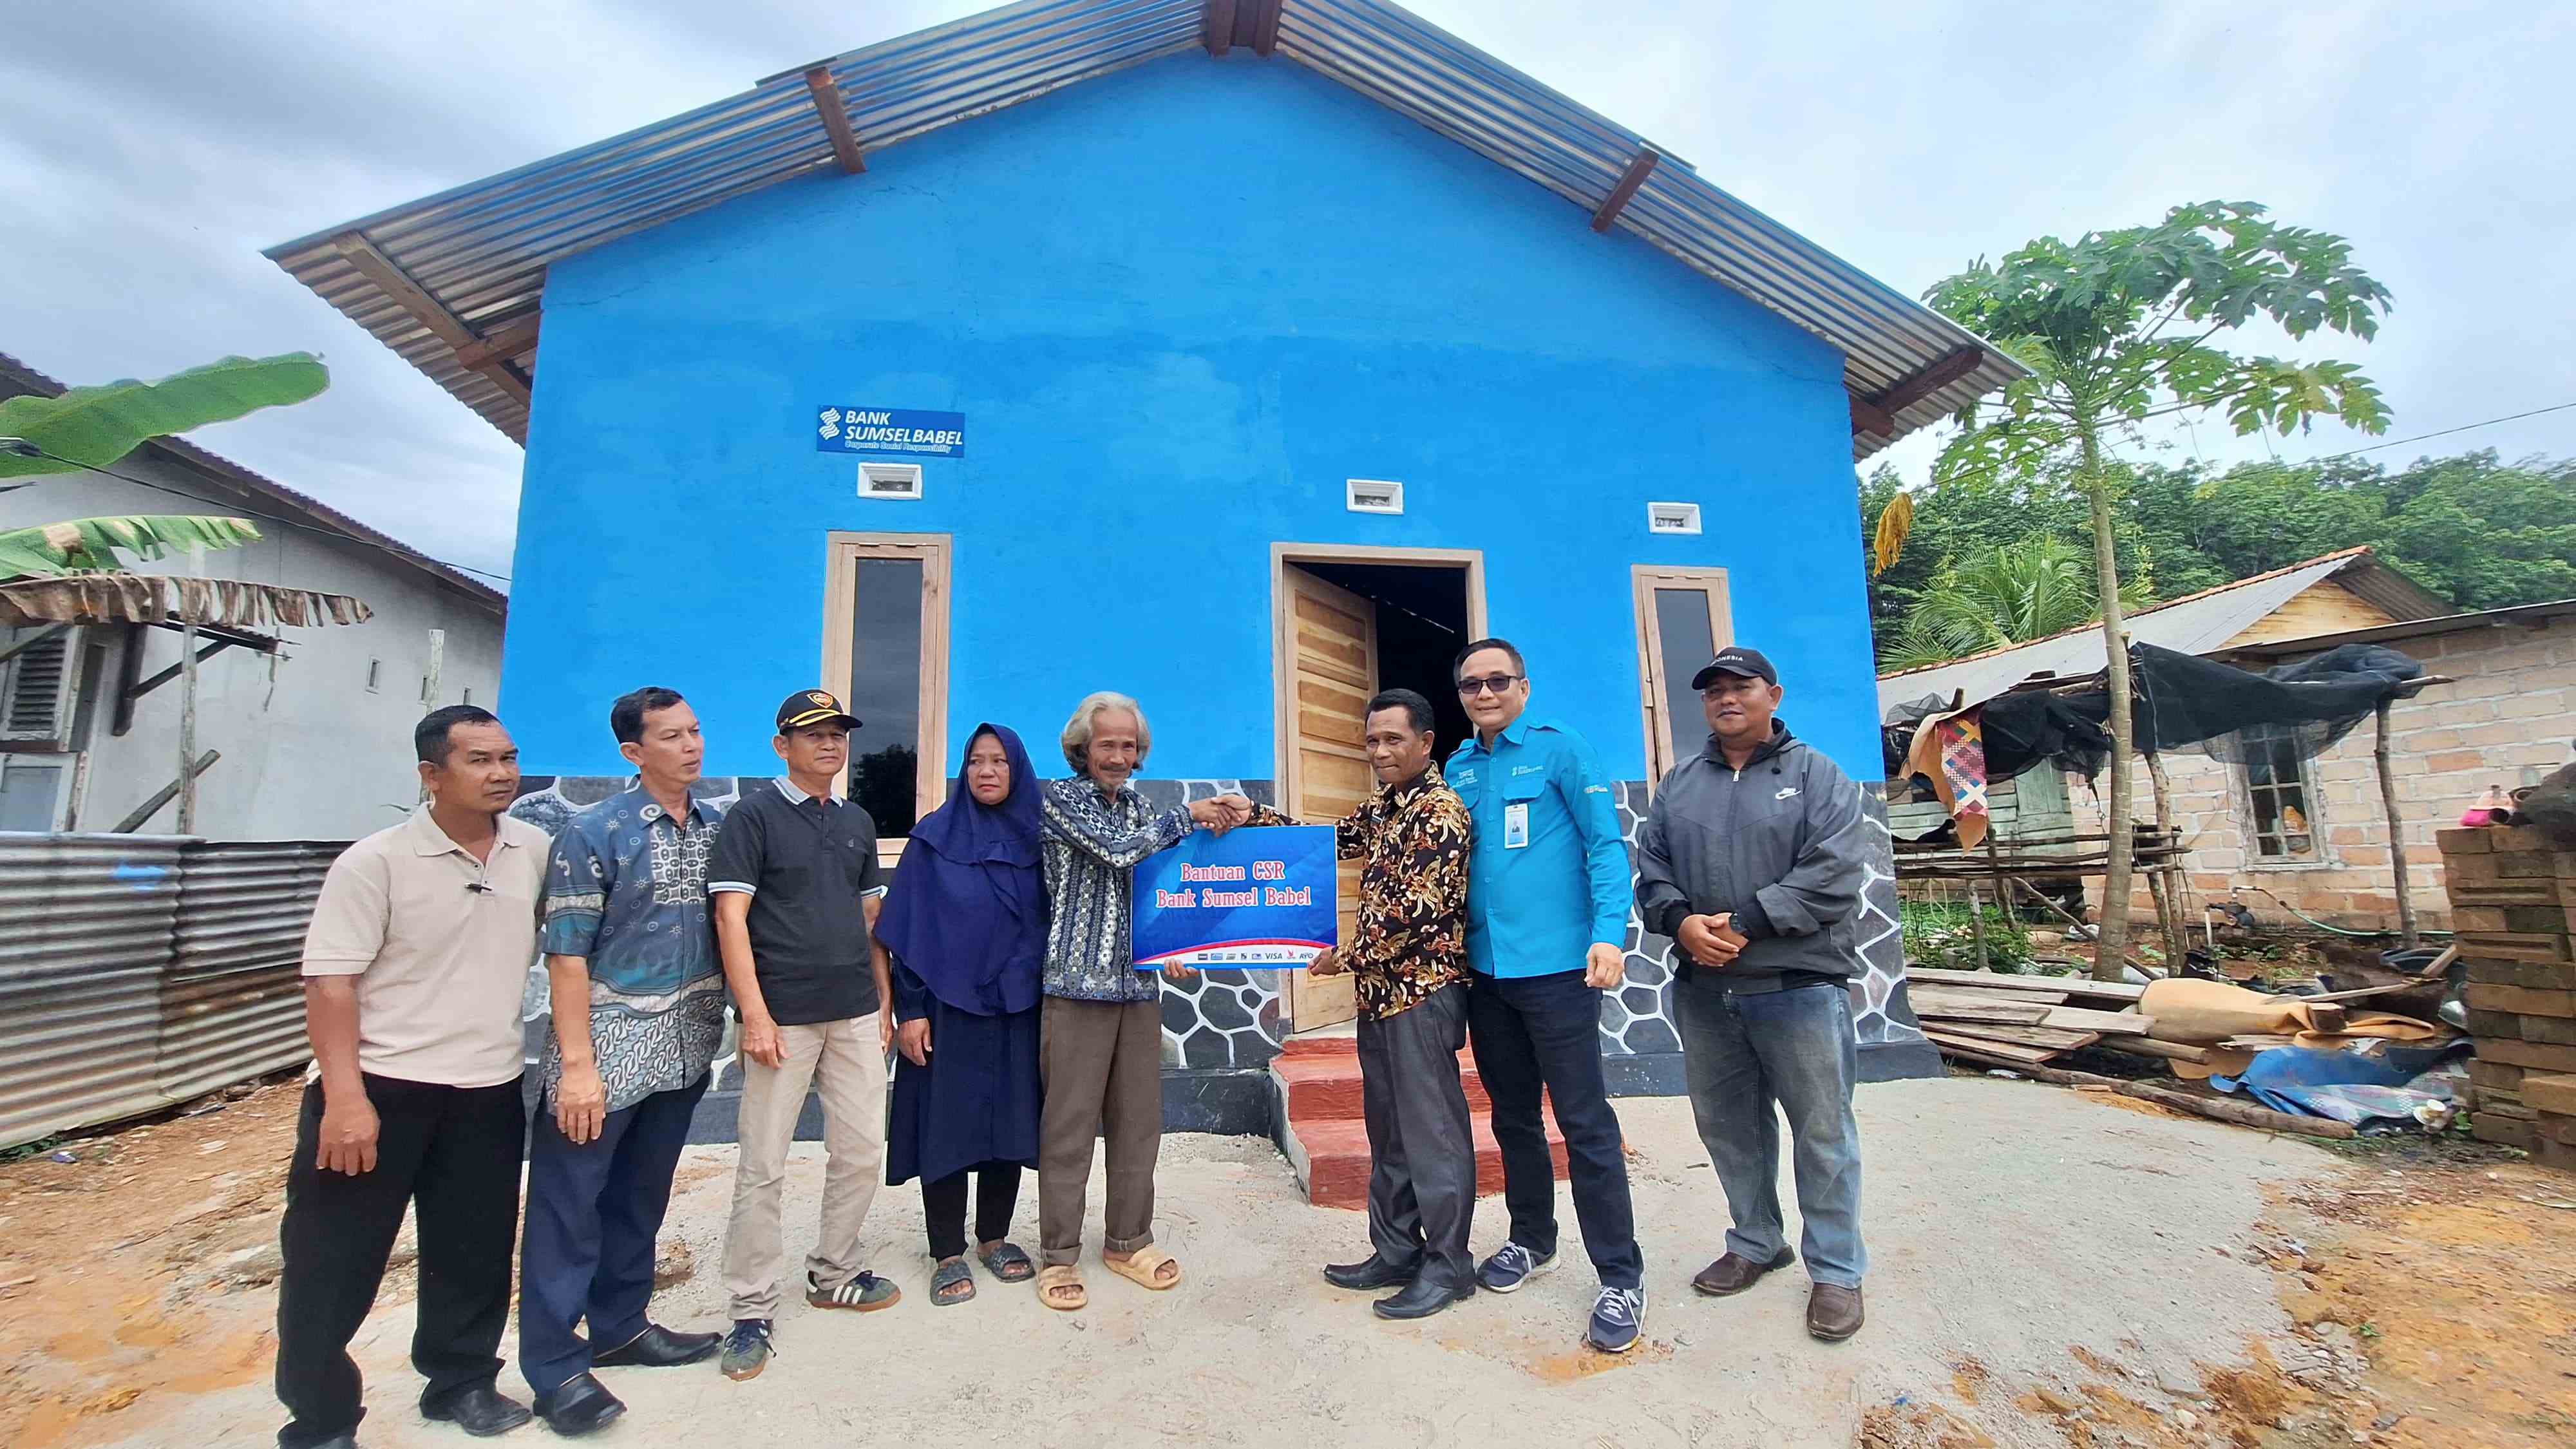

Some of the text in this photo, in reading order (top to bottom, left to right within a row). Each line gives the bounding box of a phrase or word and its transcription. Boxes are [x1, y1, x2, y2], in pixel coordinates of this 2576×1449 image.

[845, 410, 891, 425] BANK
[844, 426, 963, 445] SUMSELBABEL
[1180, 860, 1285, 882] Bantuan CSR
[1156, 886, 1311, 907] Bank Sumsel Babel
